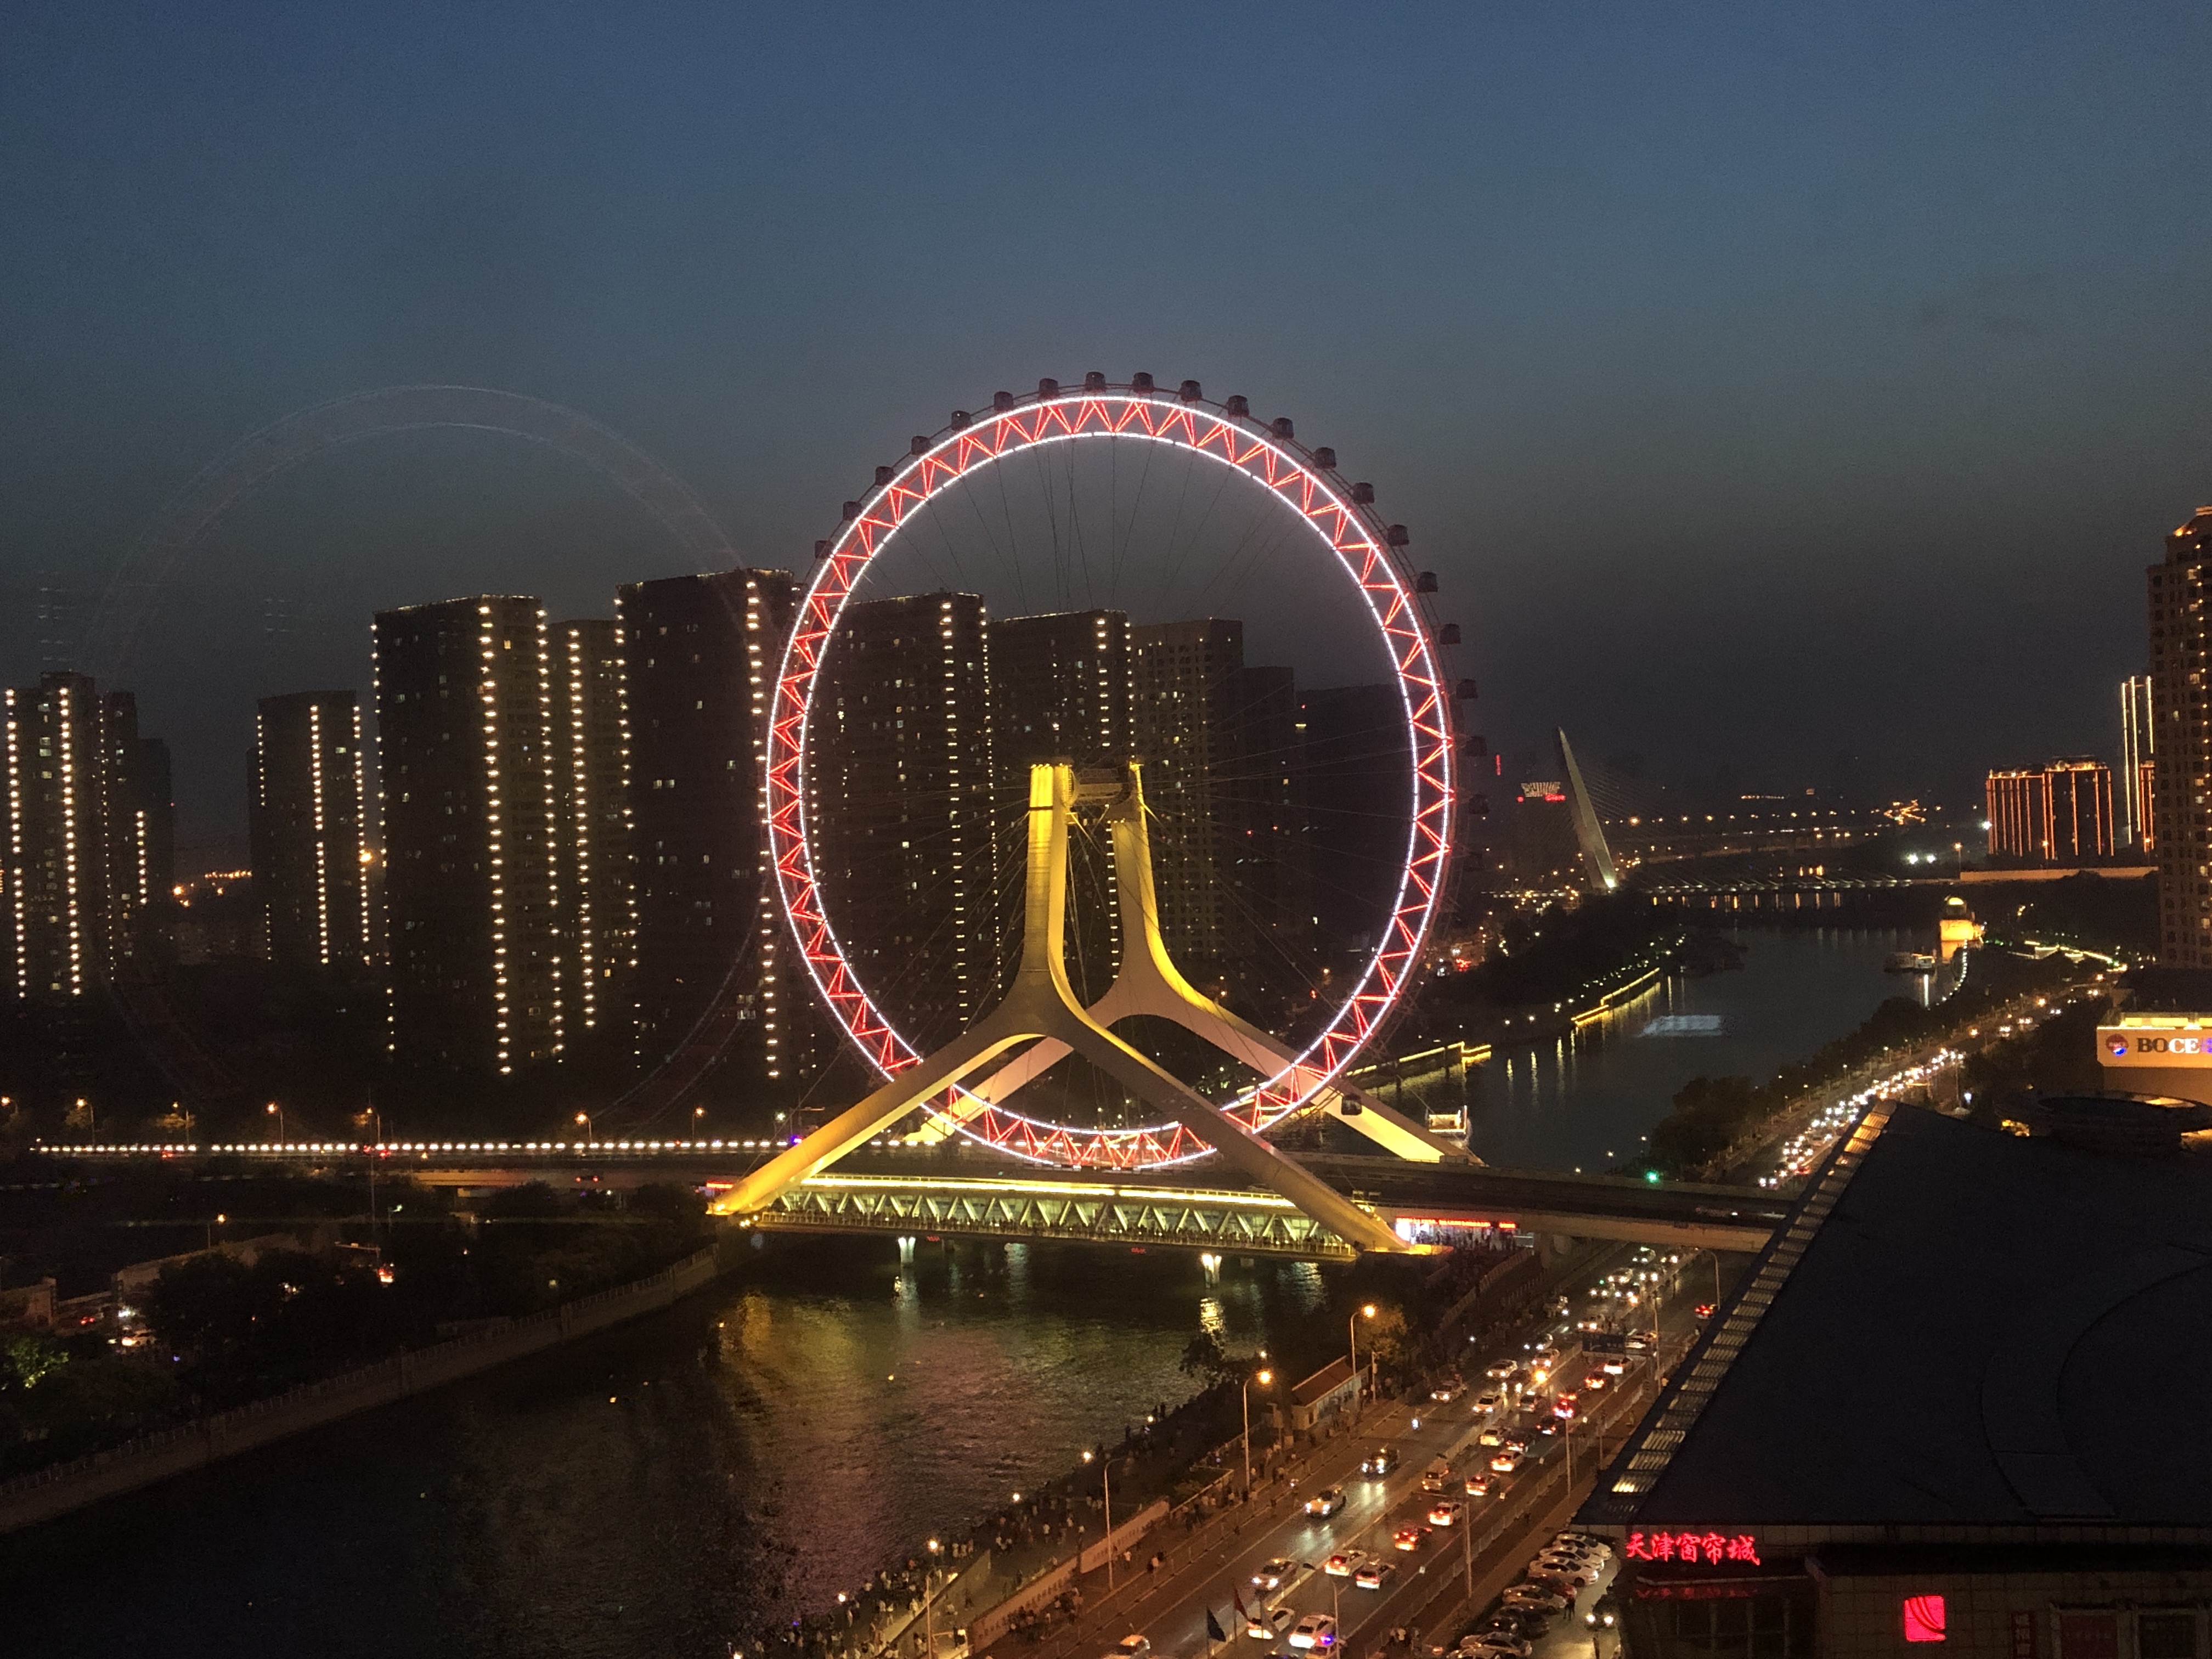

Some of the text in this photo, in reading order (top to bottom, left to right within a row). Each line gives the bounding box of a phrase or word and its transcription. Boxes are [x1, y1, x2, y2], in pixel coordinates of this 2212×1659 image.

[2137, 1037, 2200, 1054] BOCE
[1626, 1532, 1760, 1566] 天津窗帘城
